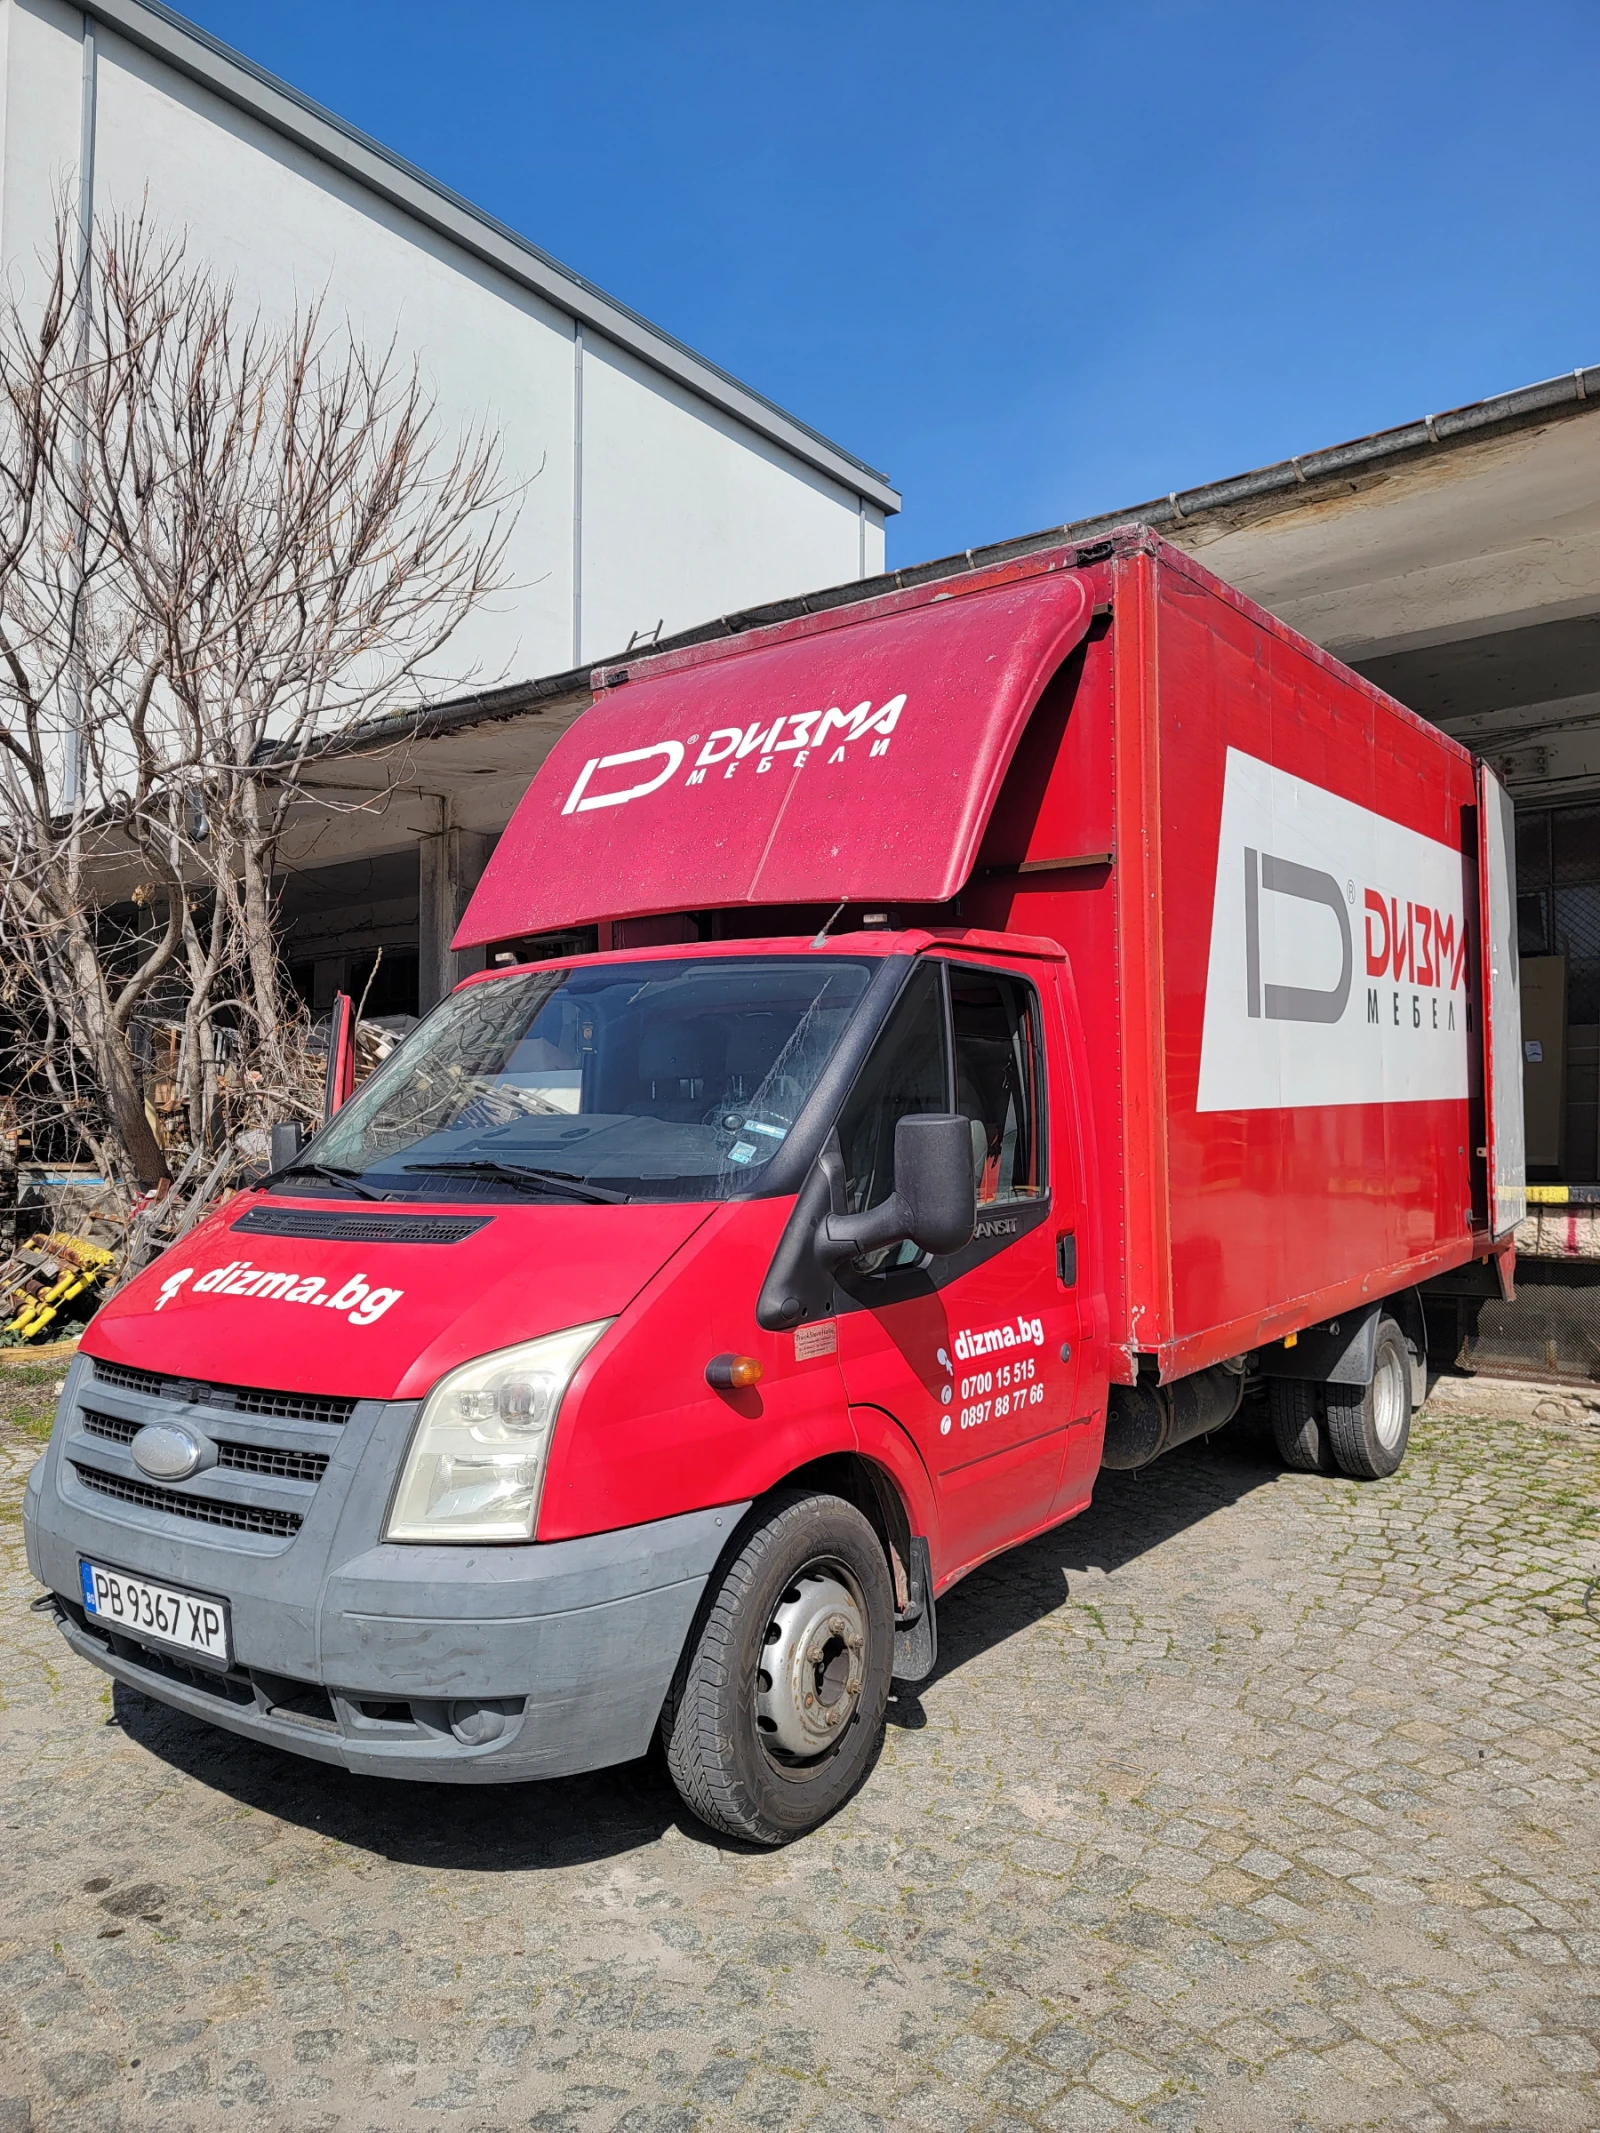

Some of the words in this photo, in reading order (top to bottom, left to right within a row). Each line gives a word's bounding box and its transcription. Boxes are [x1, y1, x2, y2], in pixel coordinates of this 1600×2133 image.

[685, 738, 890, 786] МЕБЕЛИ
[974, 1218, 1017, 1239] ANSIT
[192, 1261, 404, 1325] dizma.bg
[954, 1316, 1044, 1360] dizma.bg
[961, 1371, 992, 1399] 0700
[996, 1366, 1010, 1388] 15
[1013, 1358, 1035, 1383] 515
[960, 1401, 992, 1429] 0897
[994, 1394, 1010, 1417] 88
[1013, 1388, 1028, 1411] 77
[1030, 1383, 1044, 1404] 66
